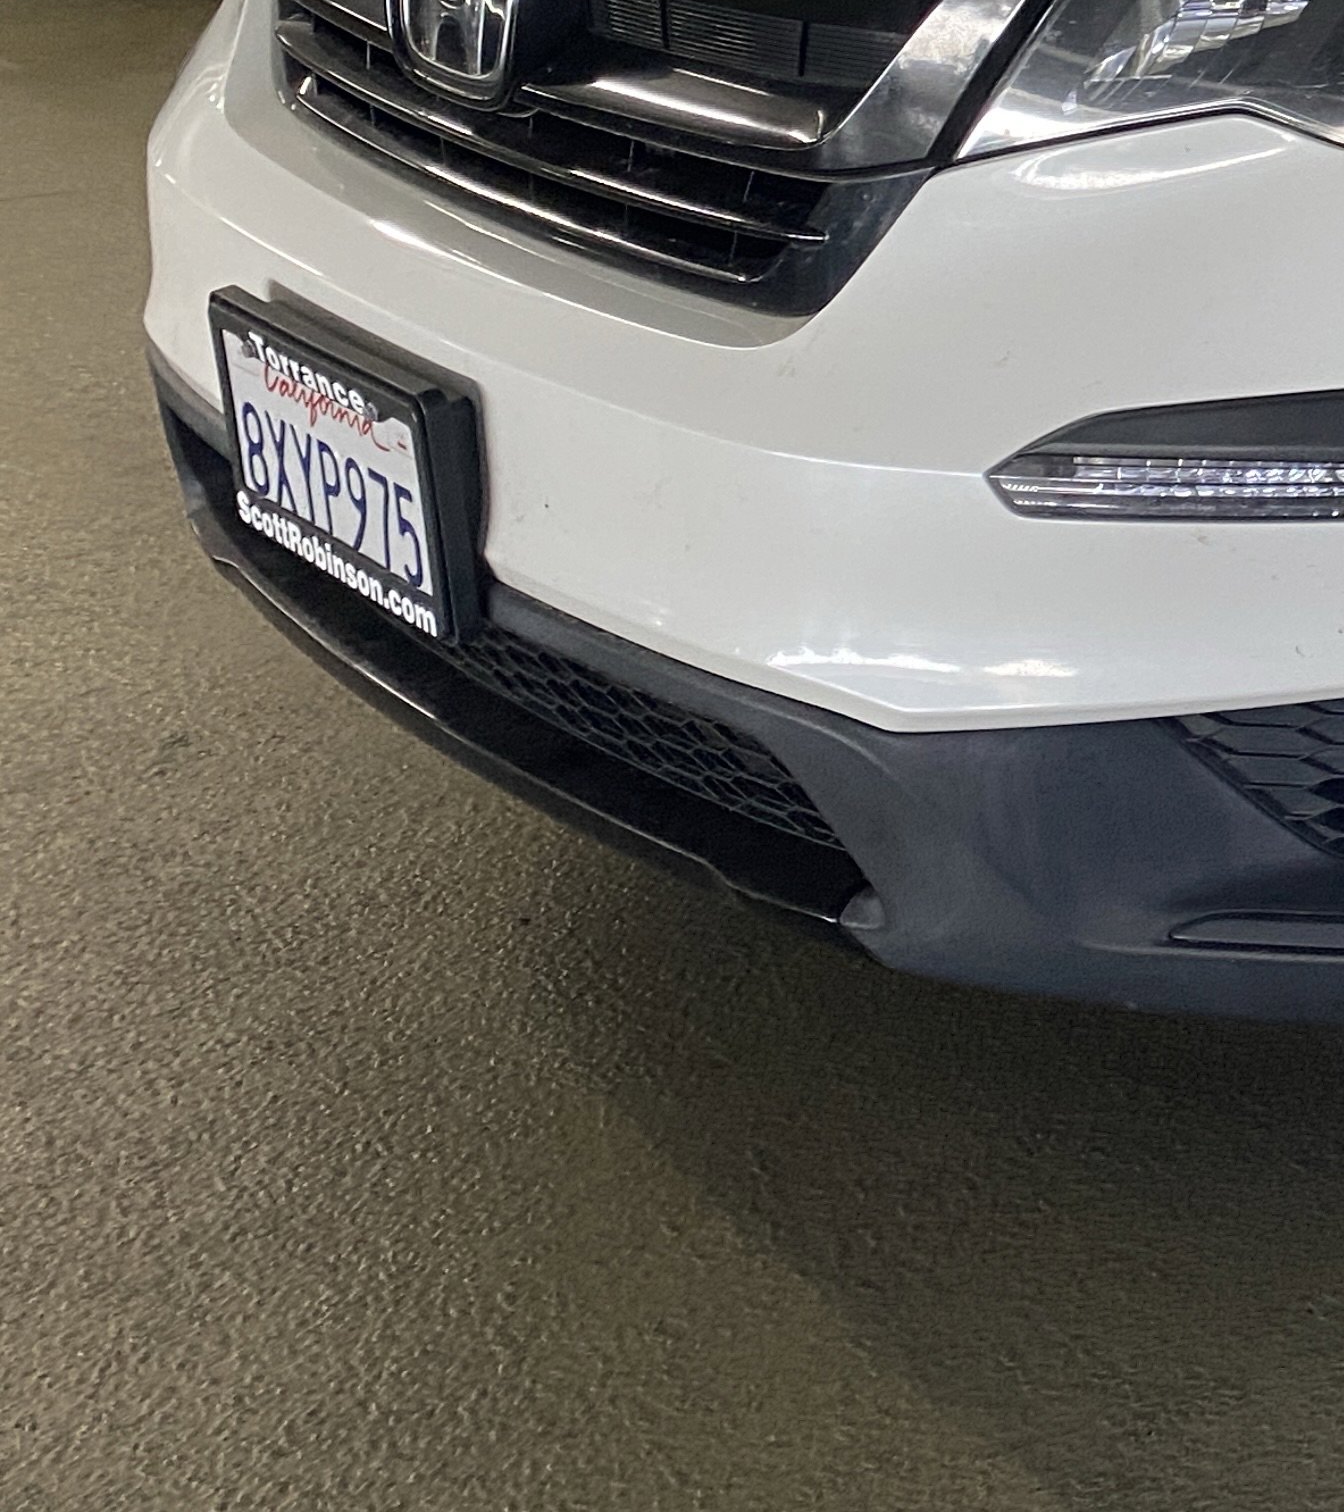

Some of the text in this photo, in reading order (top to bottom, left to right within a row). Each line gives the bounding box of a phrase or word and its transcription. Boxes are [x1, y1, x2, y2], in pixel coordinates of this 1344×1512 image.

[248, 331, 365, 415] Torrance
[236, 490, 438, 638] ScottRobinson.com
[241, 400, 424, 589] 8XYP975
